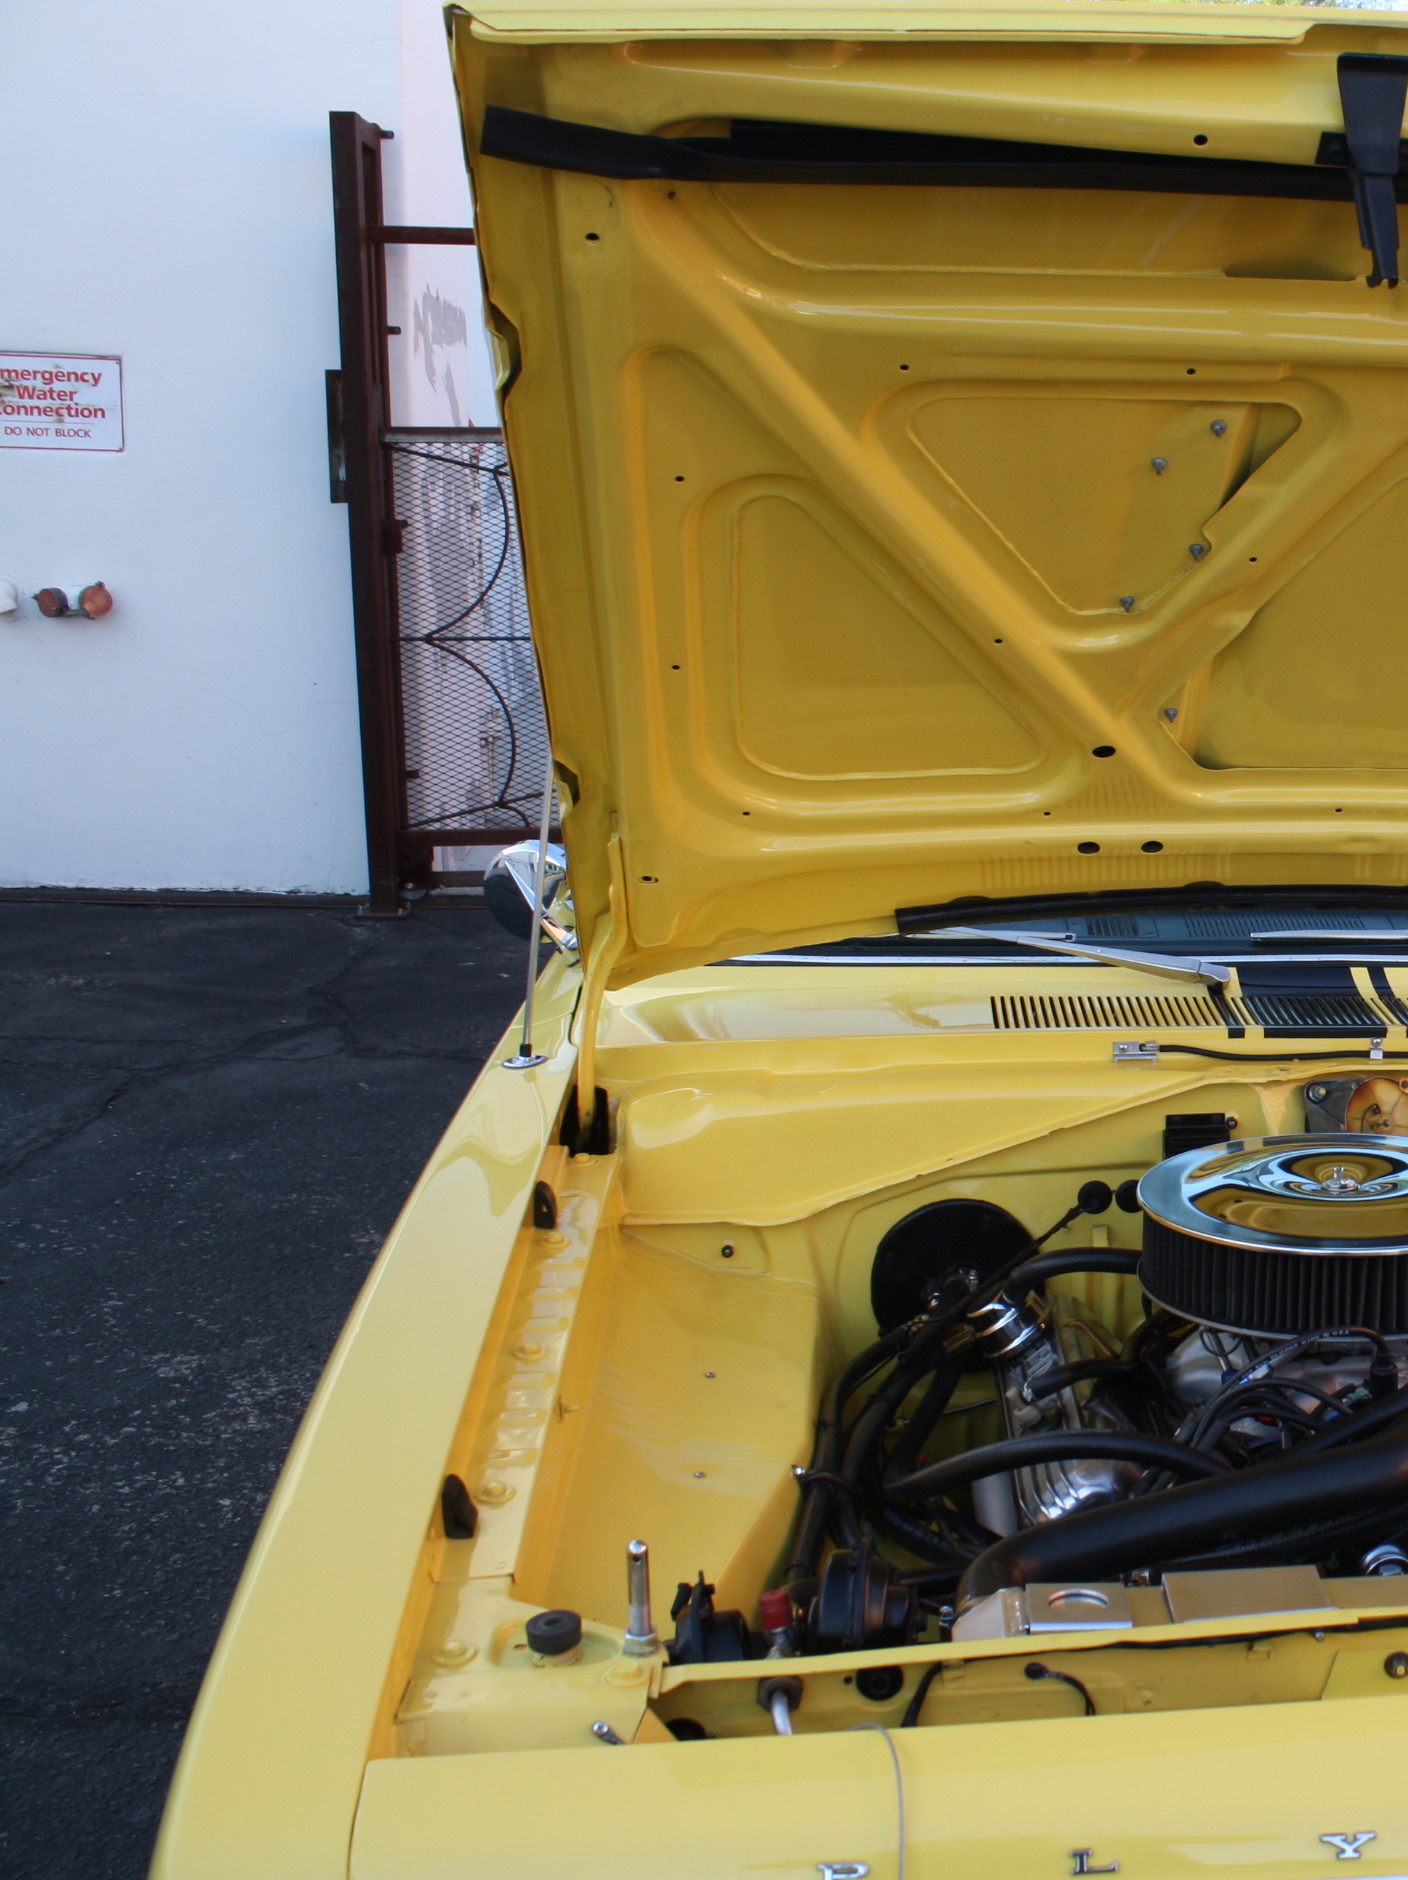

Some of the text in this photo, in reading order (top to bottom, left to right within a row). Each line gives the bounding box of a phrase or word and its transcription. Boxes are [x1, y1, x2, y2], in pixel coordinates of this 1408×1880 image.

[0, 368, 102, 386] mergency
[15, 385, 77, 401] Water
[0, 402, 105, 418] onnection
[4, 426, 91, 437] DO NOT BLOCK
